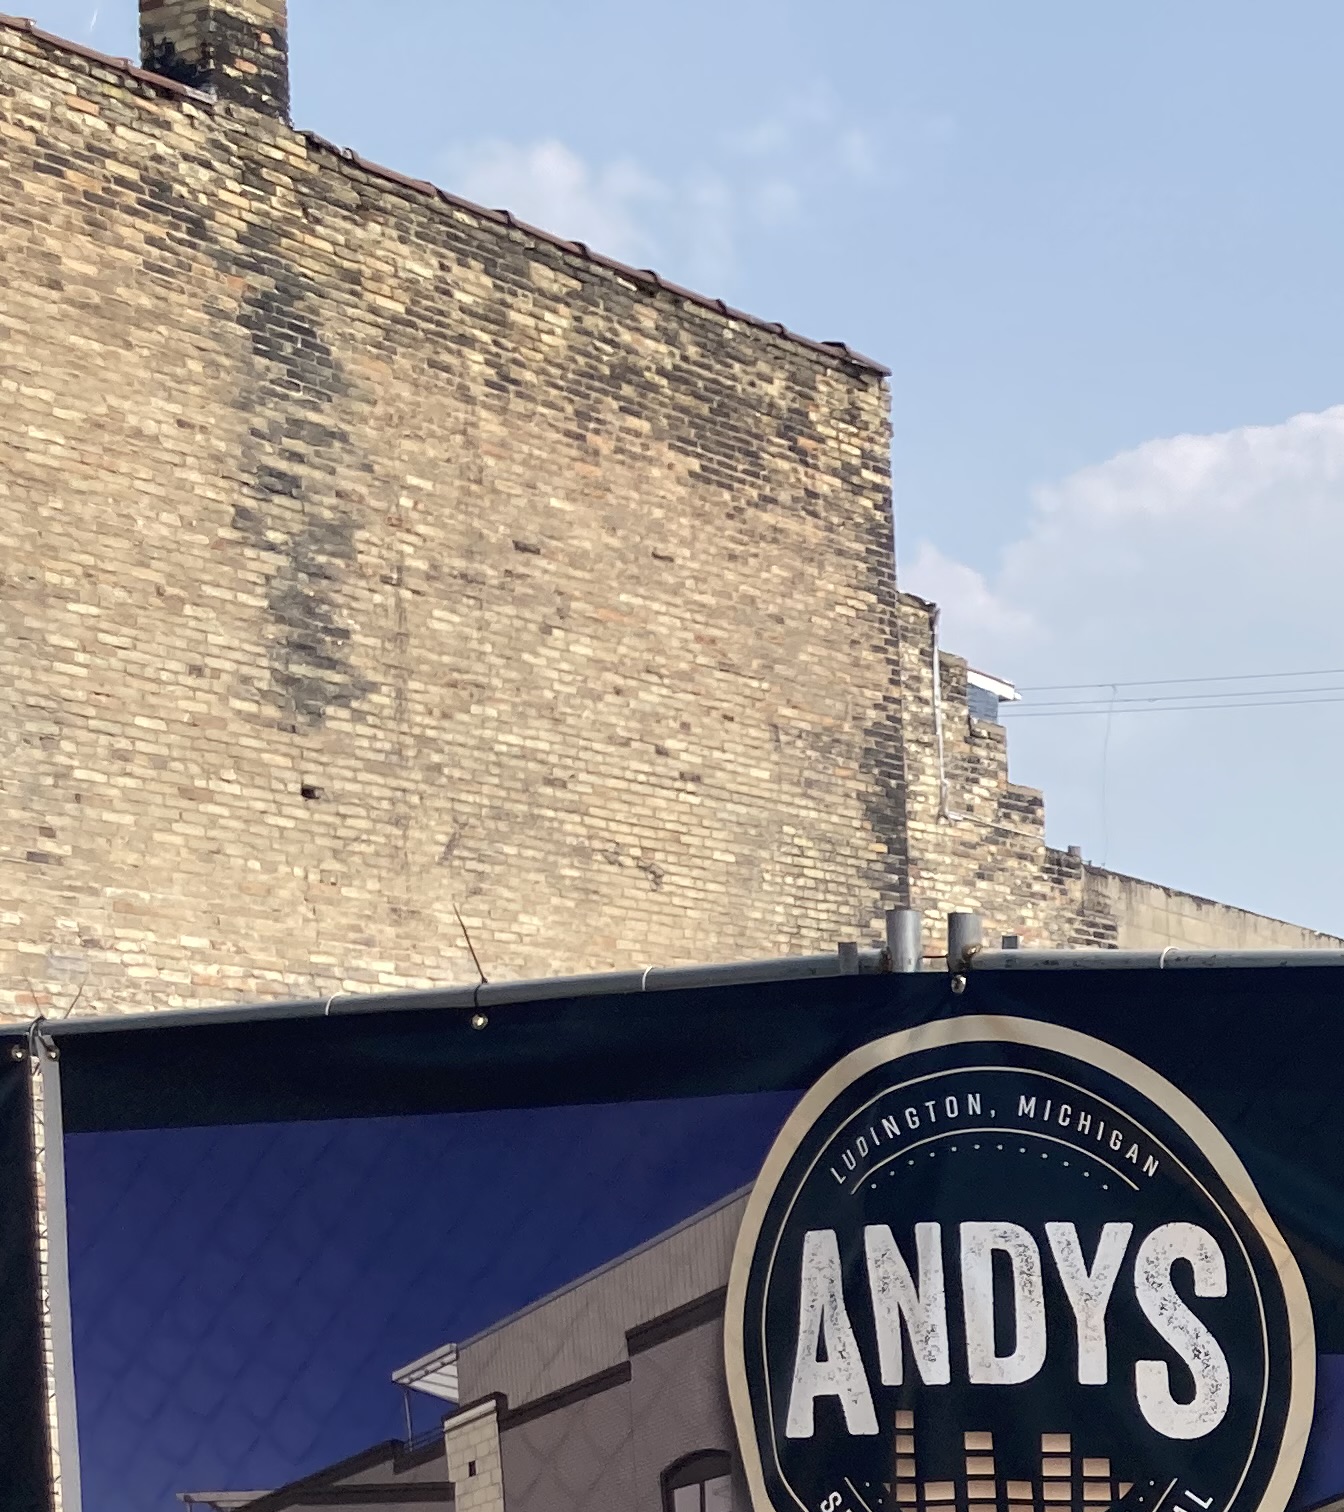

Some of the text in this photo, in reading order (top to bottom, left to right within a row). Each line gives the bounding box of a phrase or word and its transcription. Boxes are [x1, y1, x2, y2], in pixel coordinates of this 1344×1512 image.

[830, 1093, 1160, 1184] LUDINGTON, MICHIGAN
[786, 1221, 1231, 1440] ANDYS
